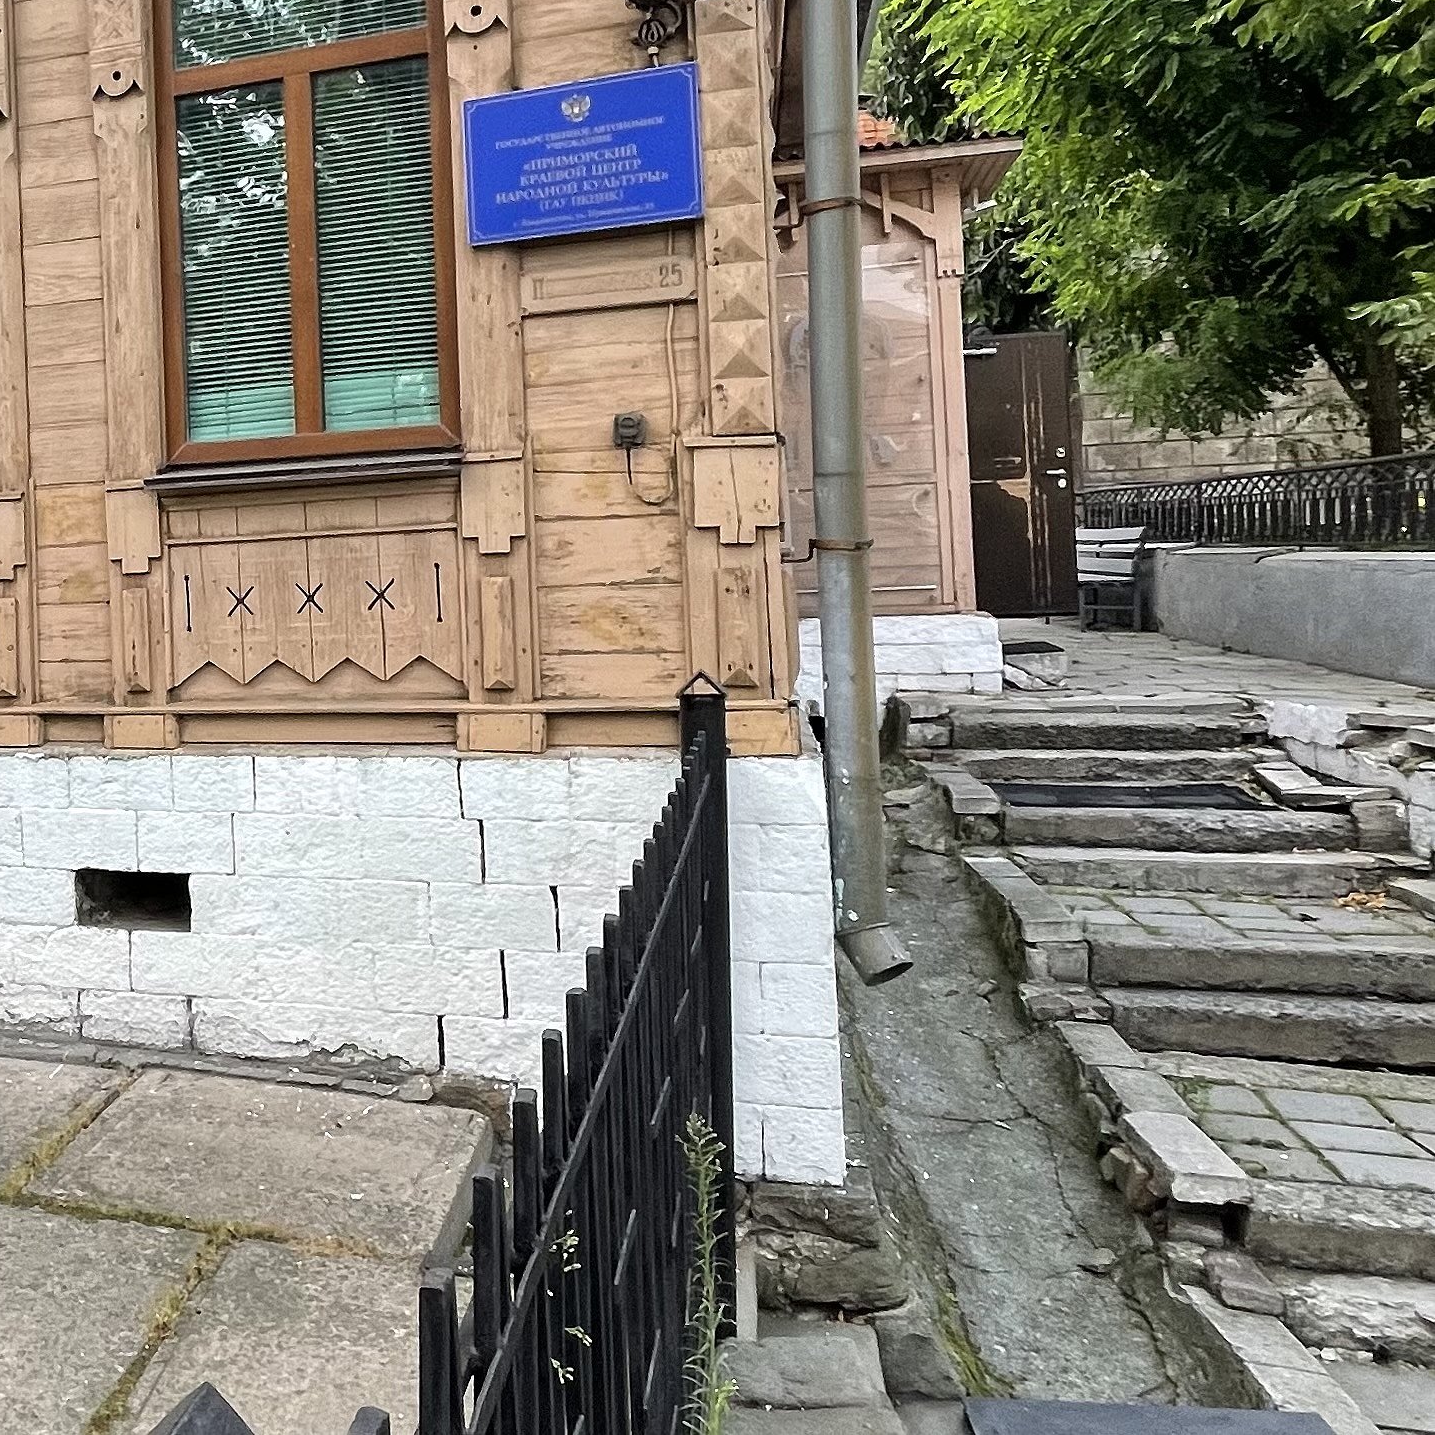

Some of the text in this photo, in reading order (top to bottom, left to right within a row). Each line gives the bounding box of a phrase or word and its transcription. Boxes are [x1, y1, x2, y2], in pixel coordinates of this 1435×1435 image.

[523, 144, 637, 171] «ПРИМОРСКИЙ
[520, 158, 641, 186] КРАЕВОЙ ЦЕНТР
[496, 170, 669, 205] НАРОДНОЙ КУЛЬТУРЫ»
[659, 263, 683, 288] 25
